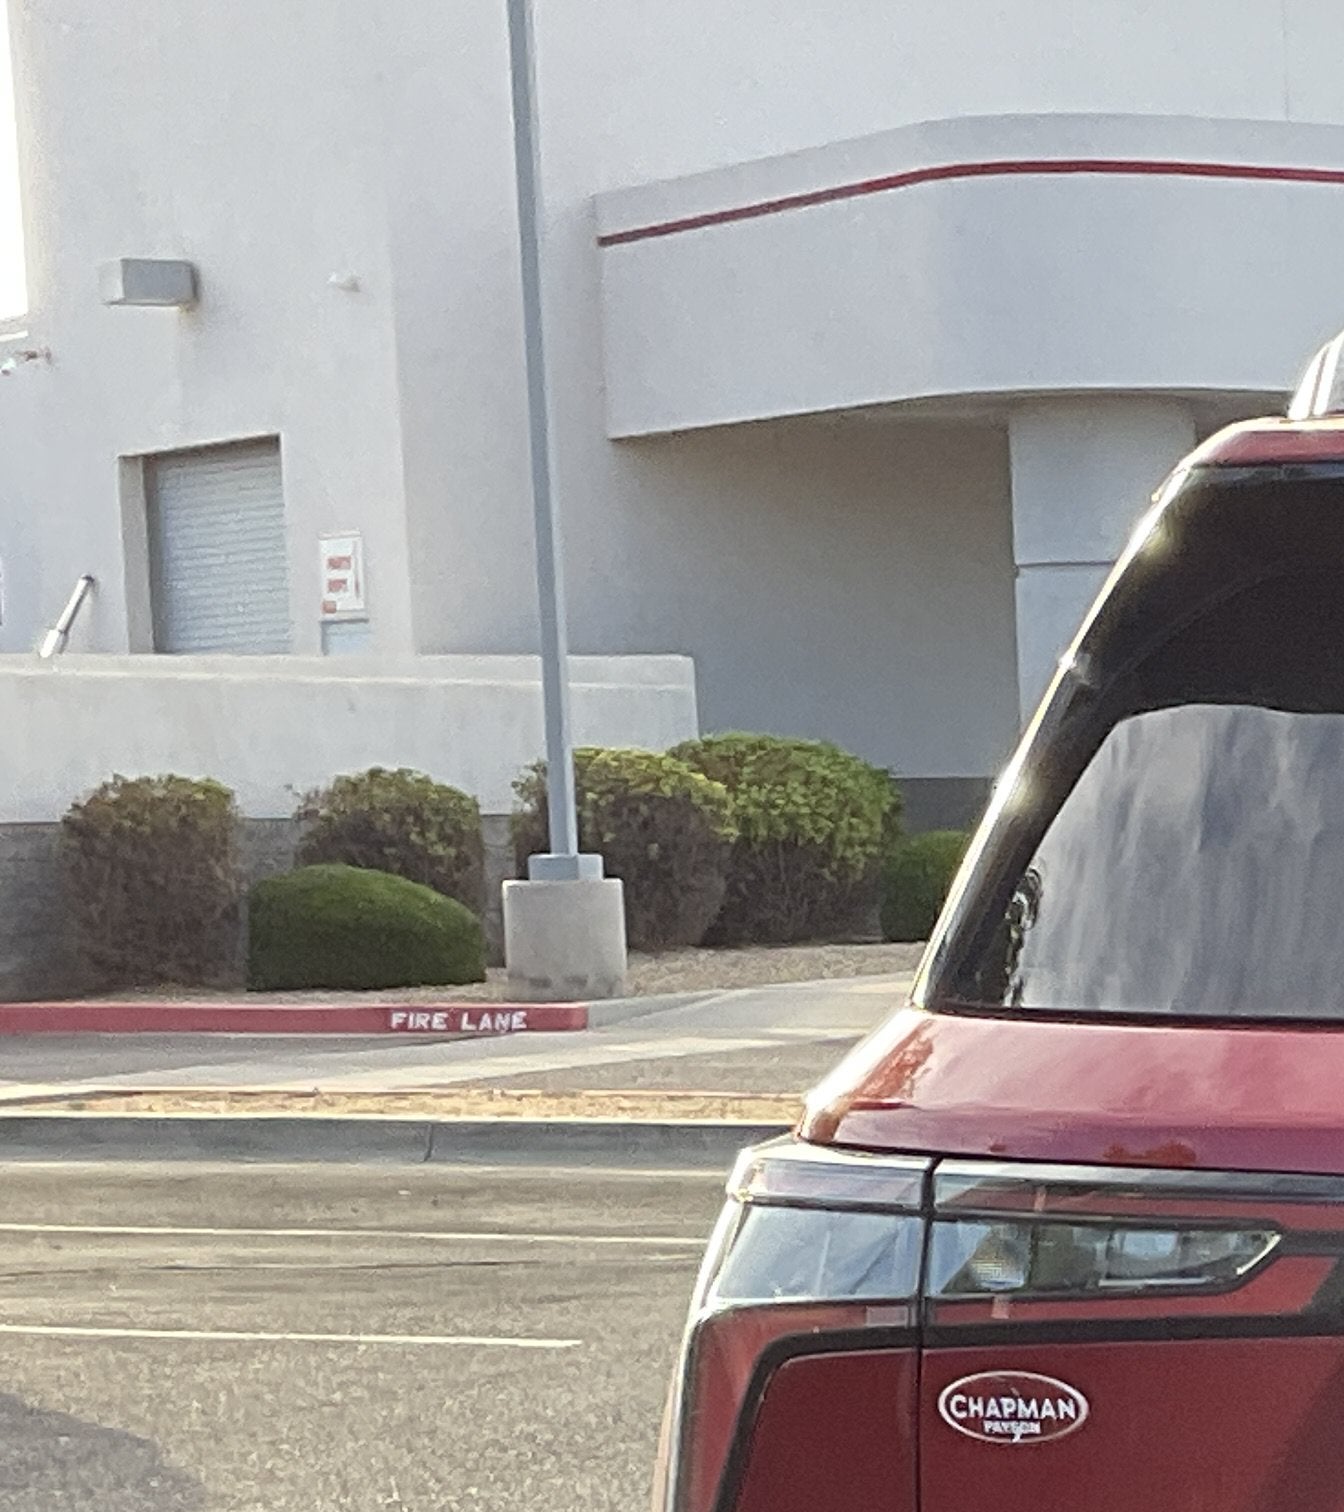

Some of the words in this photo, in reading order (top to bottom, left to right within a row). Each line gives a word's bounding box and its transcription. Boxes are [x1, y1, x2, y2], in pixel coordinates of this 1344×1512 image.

[389, 1011, 449, 1031] FIRE
[460, 1010, 528, 1033] LANE
[949, 1394, 1077, 1420] CHAPMAN
